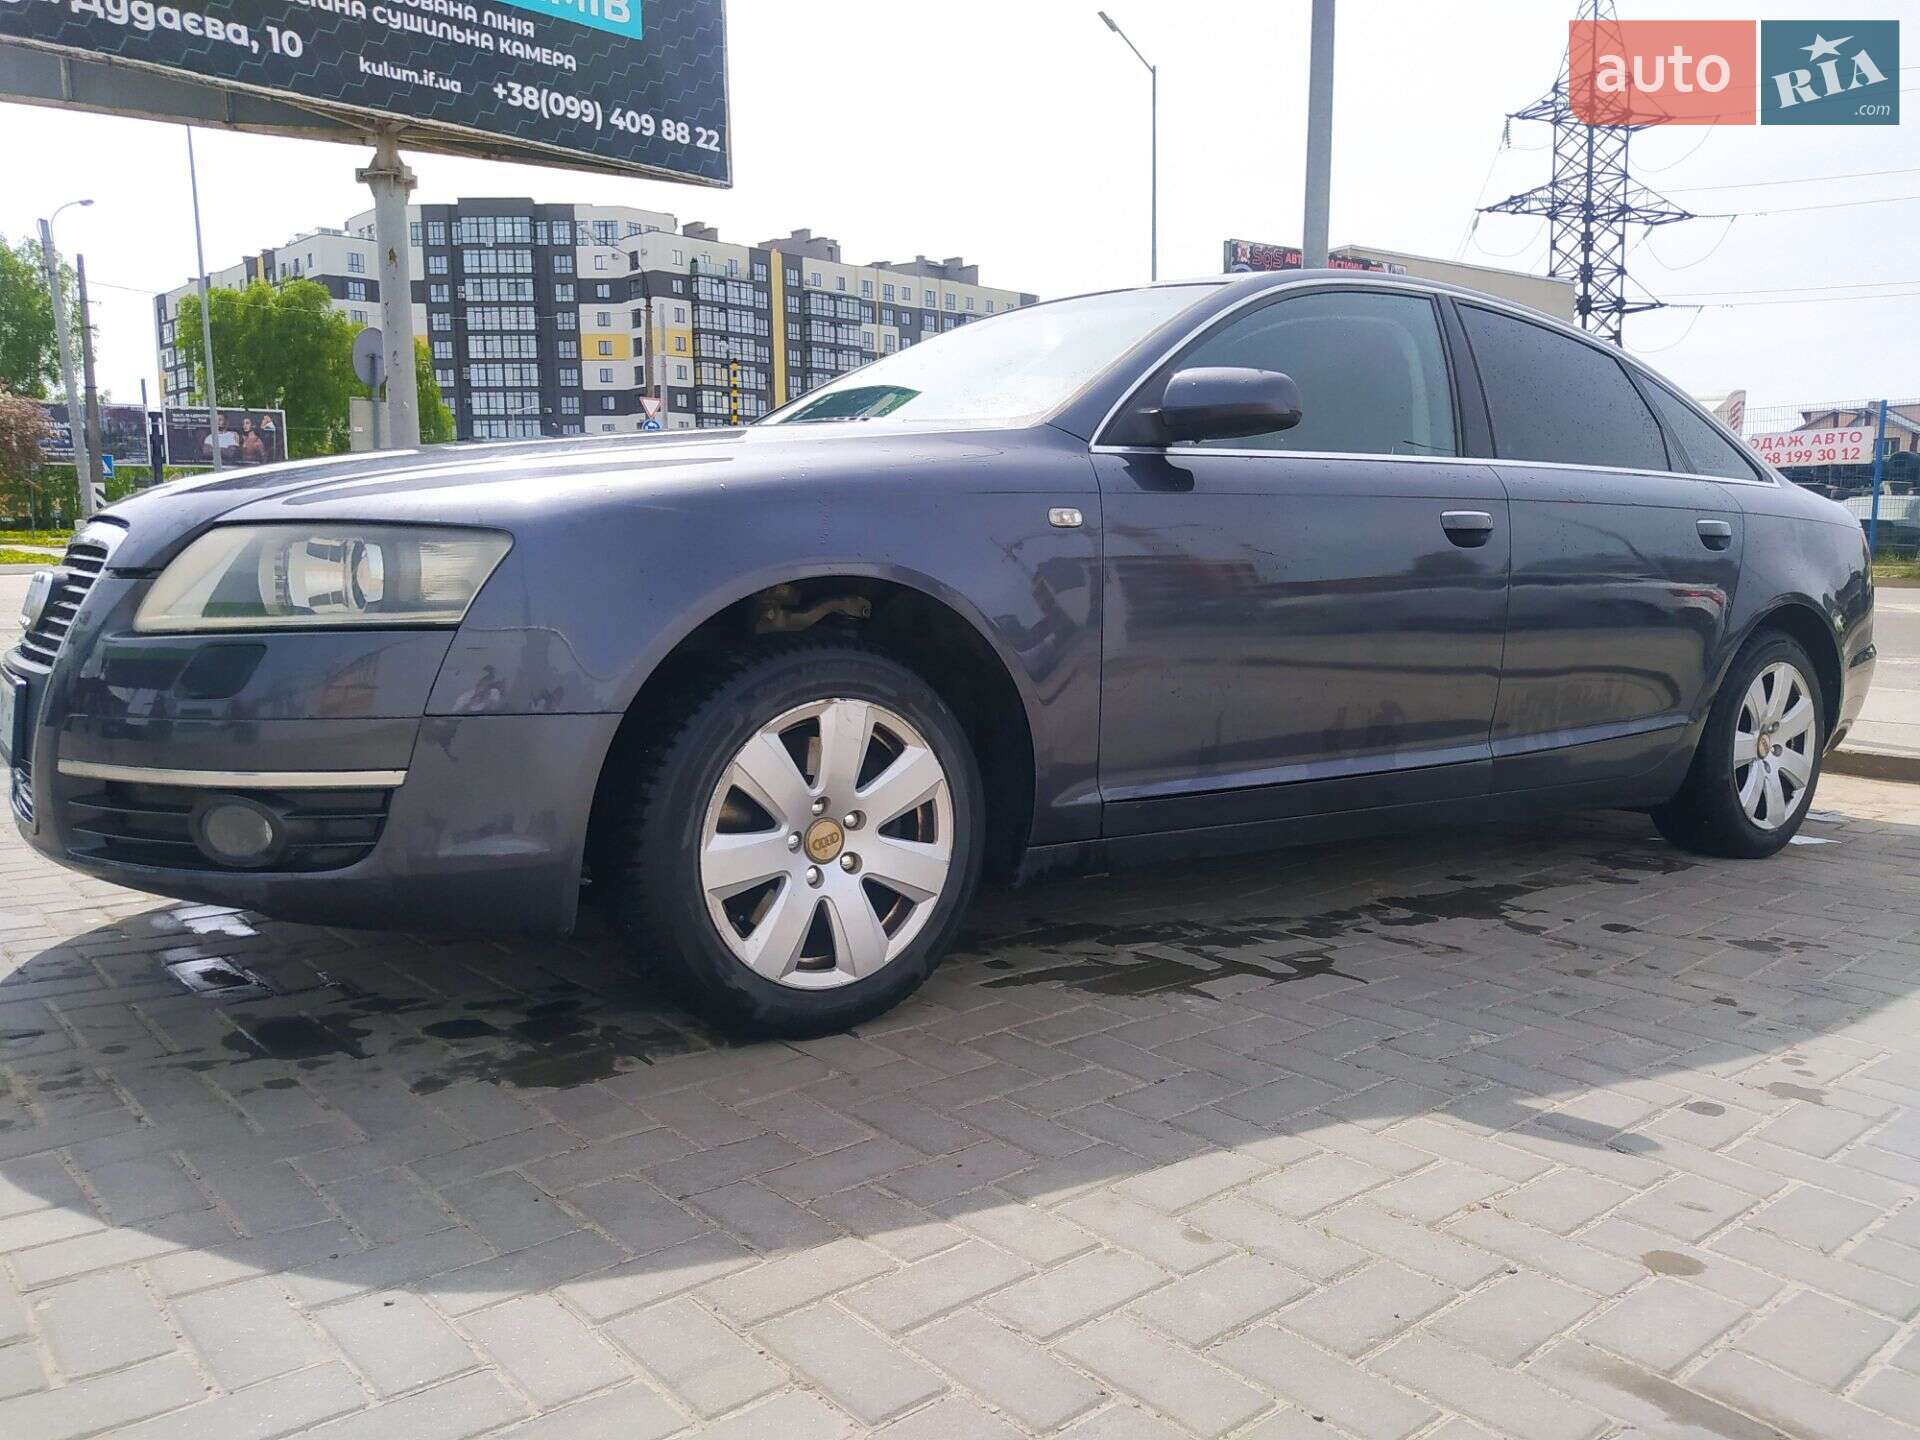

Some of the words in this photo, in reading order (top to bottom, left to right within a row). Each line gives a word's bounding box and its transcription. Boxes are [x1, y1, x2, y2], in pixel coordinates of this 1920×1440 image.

[372, 5, 494, 51] СУШИЛЬНА
[499, 37, 577, 72] КАМЕРА
[483, 10, 535, 38] ЛІНІЯ
[266, 25, 304, 58] 10
[359, 56, 462, 94] kulum.if.ua
[493, 82, 602, 130] +38(099)
[610, 108, 656, 136] 409
[661, 118, 690, 144] 88
[695, 127, 721, 152] 22
[1751, 434, 1806, 452] ОДАЖ
[1811, 431, 1863, 446] АВТО
[1786, 450, 1812, 463] 199
[1818, 449, 1836, 461] 30
[1842, 447, 1861, 461] 12
